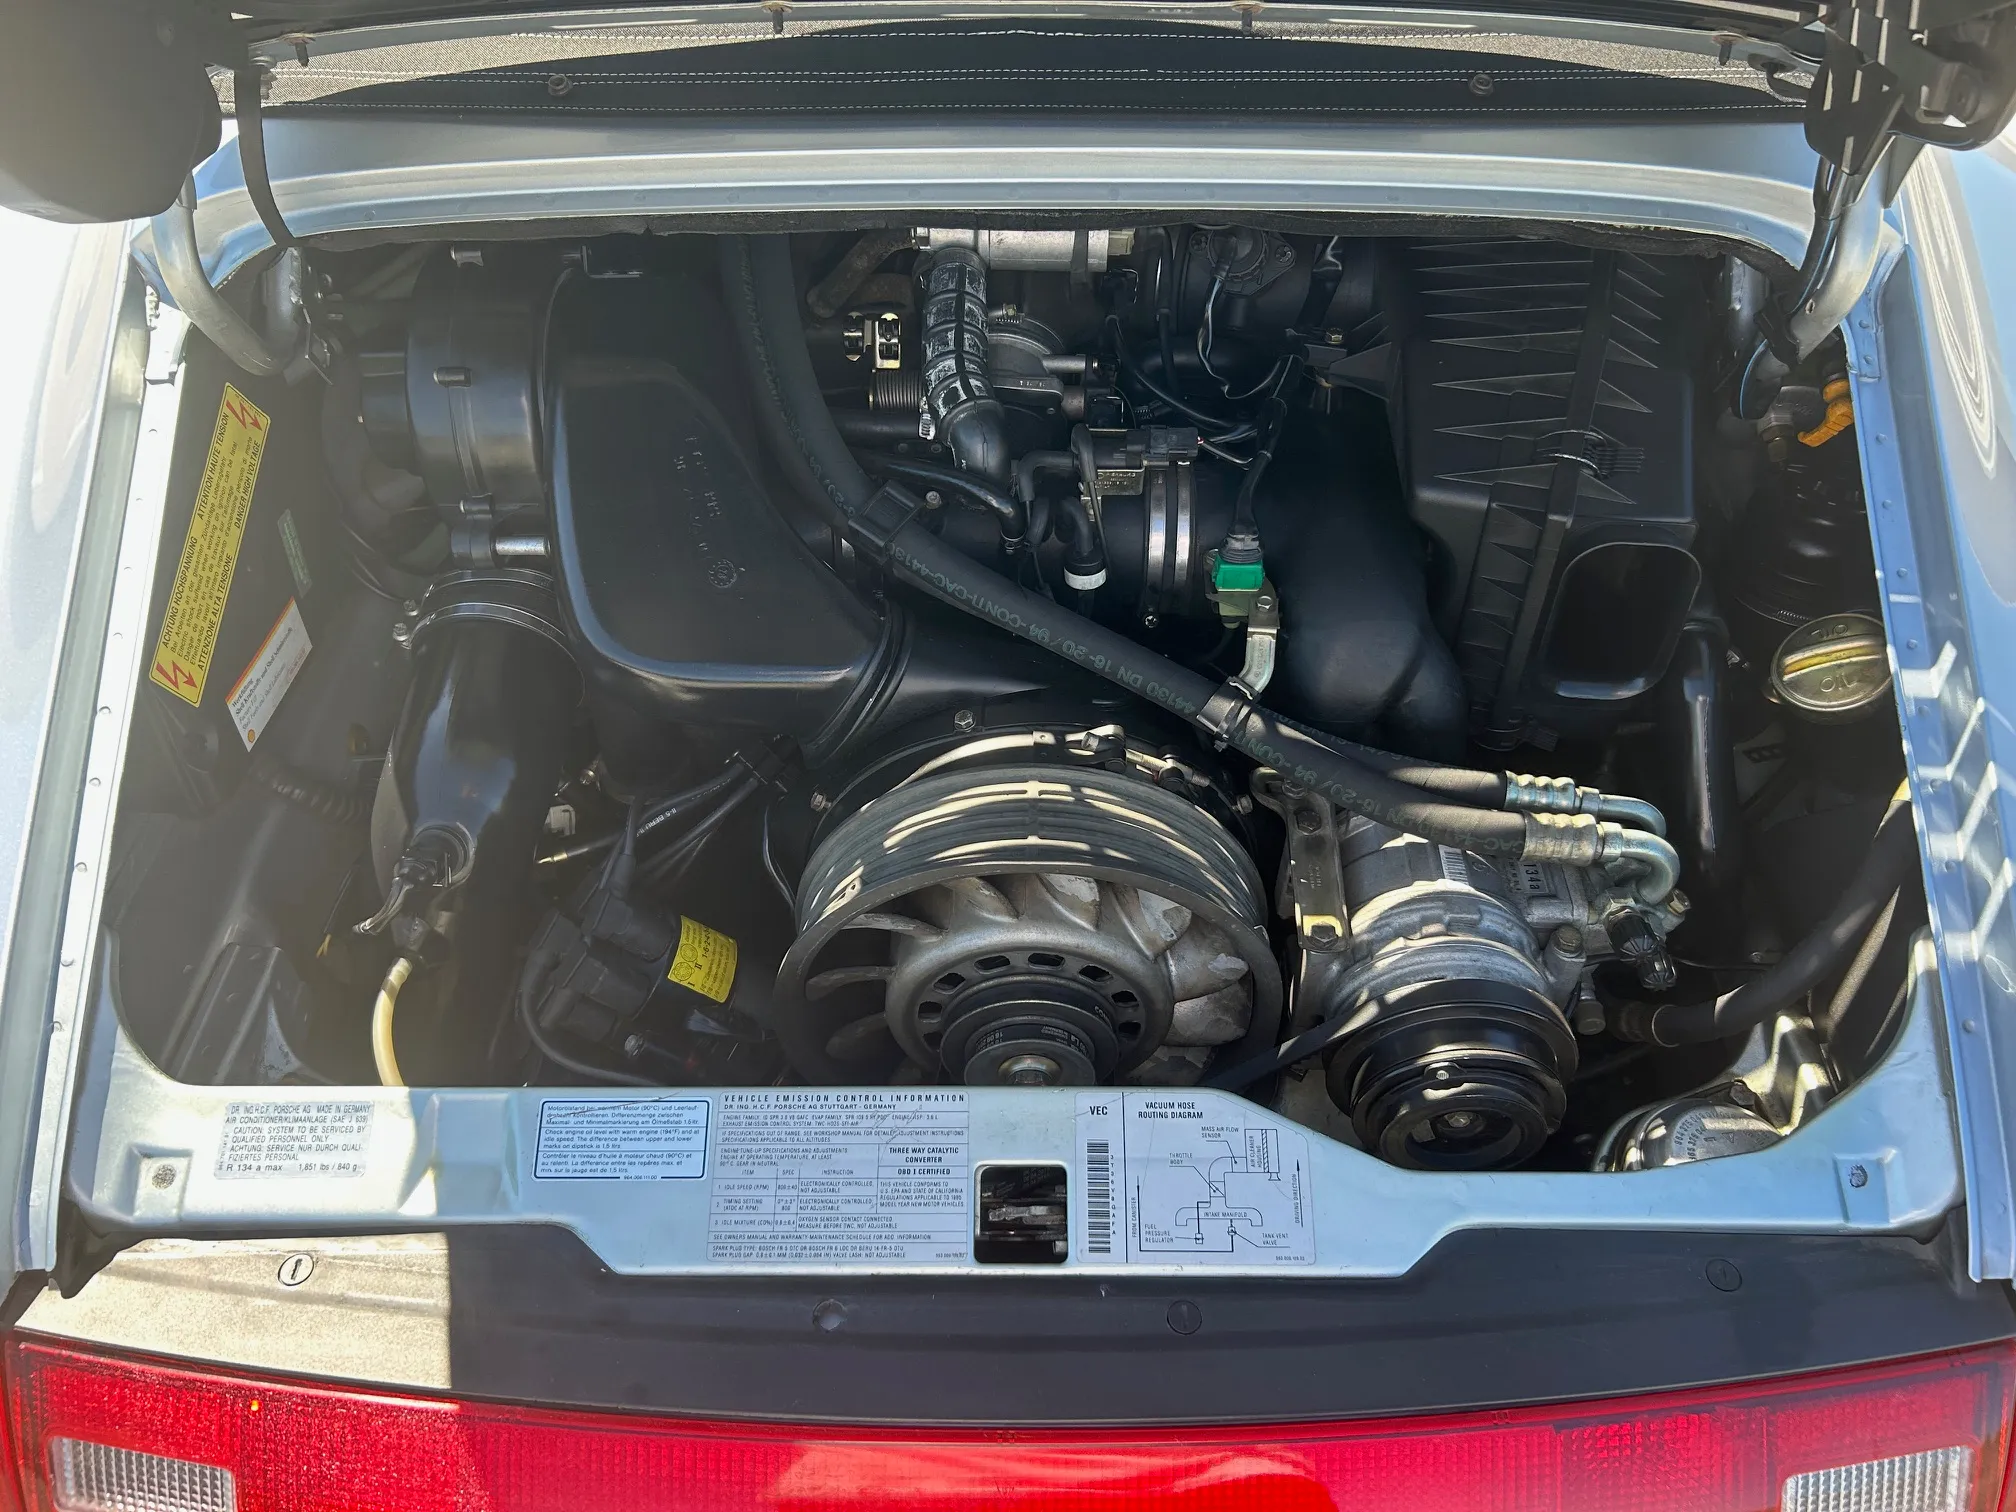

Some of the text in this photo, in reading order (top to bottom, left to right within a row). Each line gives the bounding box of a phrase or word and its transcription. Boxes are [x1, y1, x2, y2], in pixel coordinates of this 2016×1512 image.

[197, 413, 229, 520] ATTENTION HAUTE TENSION
[198, 442, 260, 671] ATTENZIONE ALTA TENSIONE DANGER HIGH VOLTAGE
[162, 536, 197, 648] ACHTUNG HOCHSPANNUNG
[1811, 624, 1848, 638] OIL
[1820, 673, 1857, 692] OIL
[645, 814, 664, 829] BERU
[1523, 864, 1541, 890] 134a
[274, 1105, 300, 1113] PORSCHE
[302, 1105, 311, 1113] AG
[317, 1105, 332, 1113] MADE
[335, 1105, 341, 1113] IN
[344, 1105, 370, 1113] GERMANY
[1145, 1102, 1195, 1110] VACUUM HOSE
[1090, 1106, 1108, 1116] VEC
[1138, 1111, 1203, 1119] ROUTING DIAGRAM
[225, 1116, 236, 1124] AIR
[331, 1116, 345, 1124] (SAE
[348, 1116, 352, 1124] J
[234, 1126, 263, 1134] CAUTION:
[268, 1126, 294, 1134] SYSTEM
[232, 1135, 266, 1143] QUALIFIED
[269, 1135, 307, 1143] PERSONNEL
[228, 1153, 262, 1161] FIZIERTES
[320, 1163, 329, 1171] lbs
